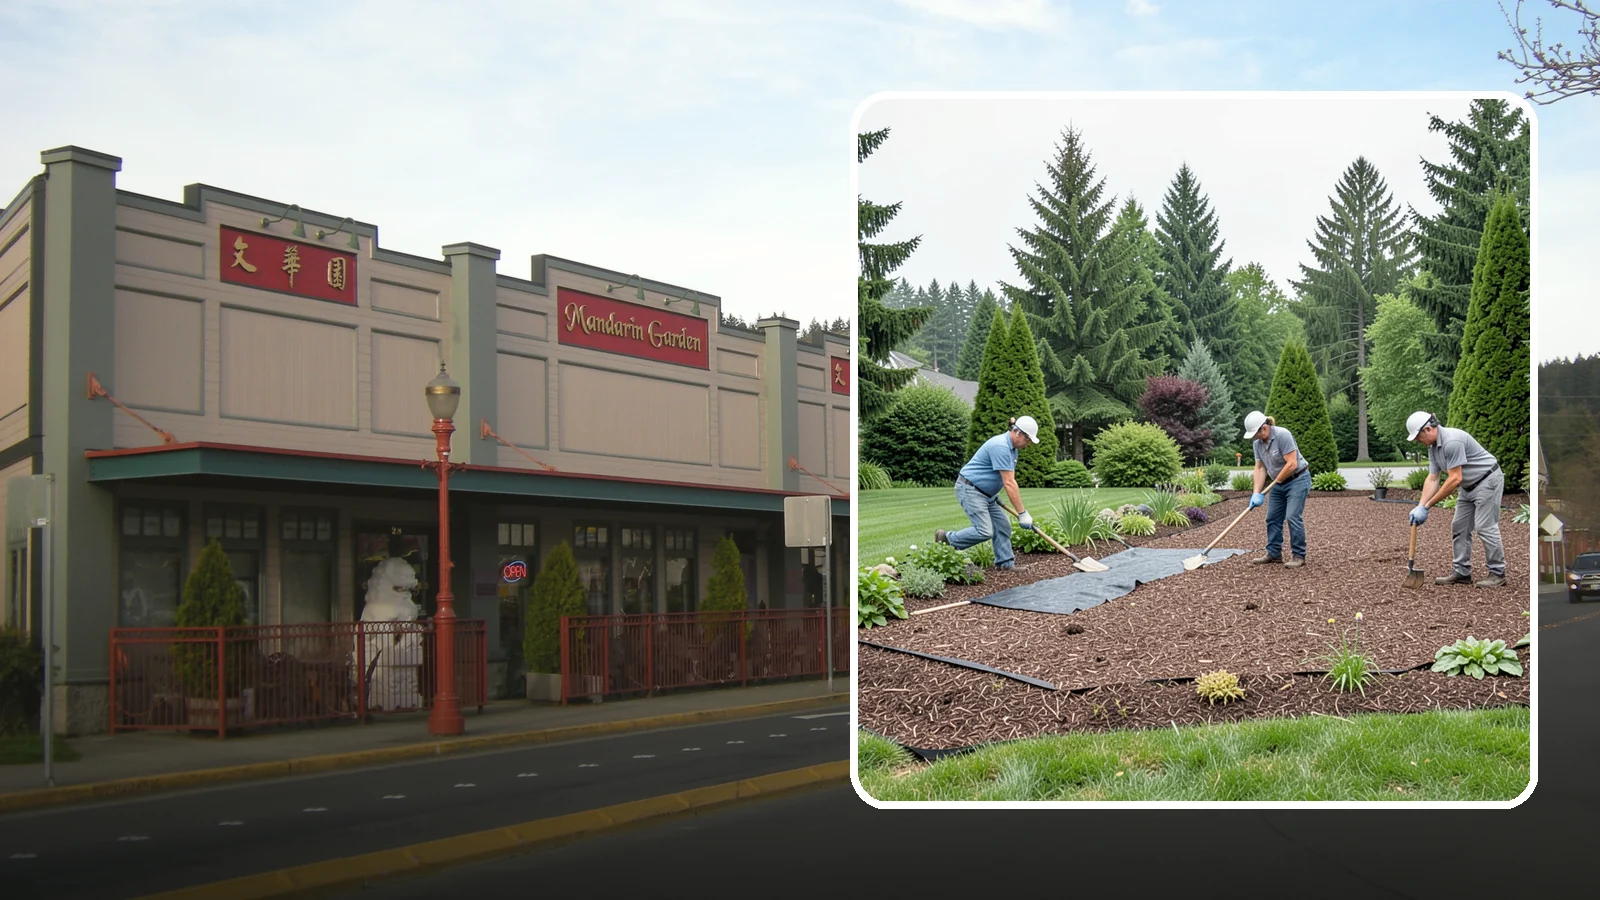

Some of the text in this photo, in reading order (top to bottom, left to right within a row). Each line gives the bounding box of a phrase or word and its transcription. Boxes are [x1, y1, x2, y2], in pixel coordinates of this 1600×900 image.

[230, 235, 346, 291] 文華園
[564, 302, 701, 352] Mandarin Garden
[503, 565, 527, 578] OPEN
